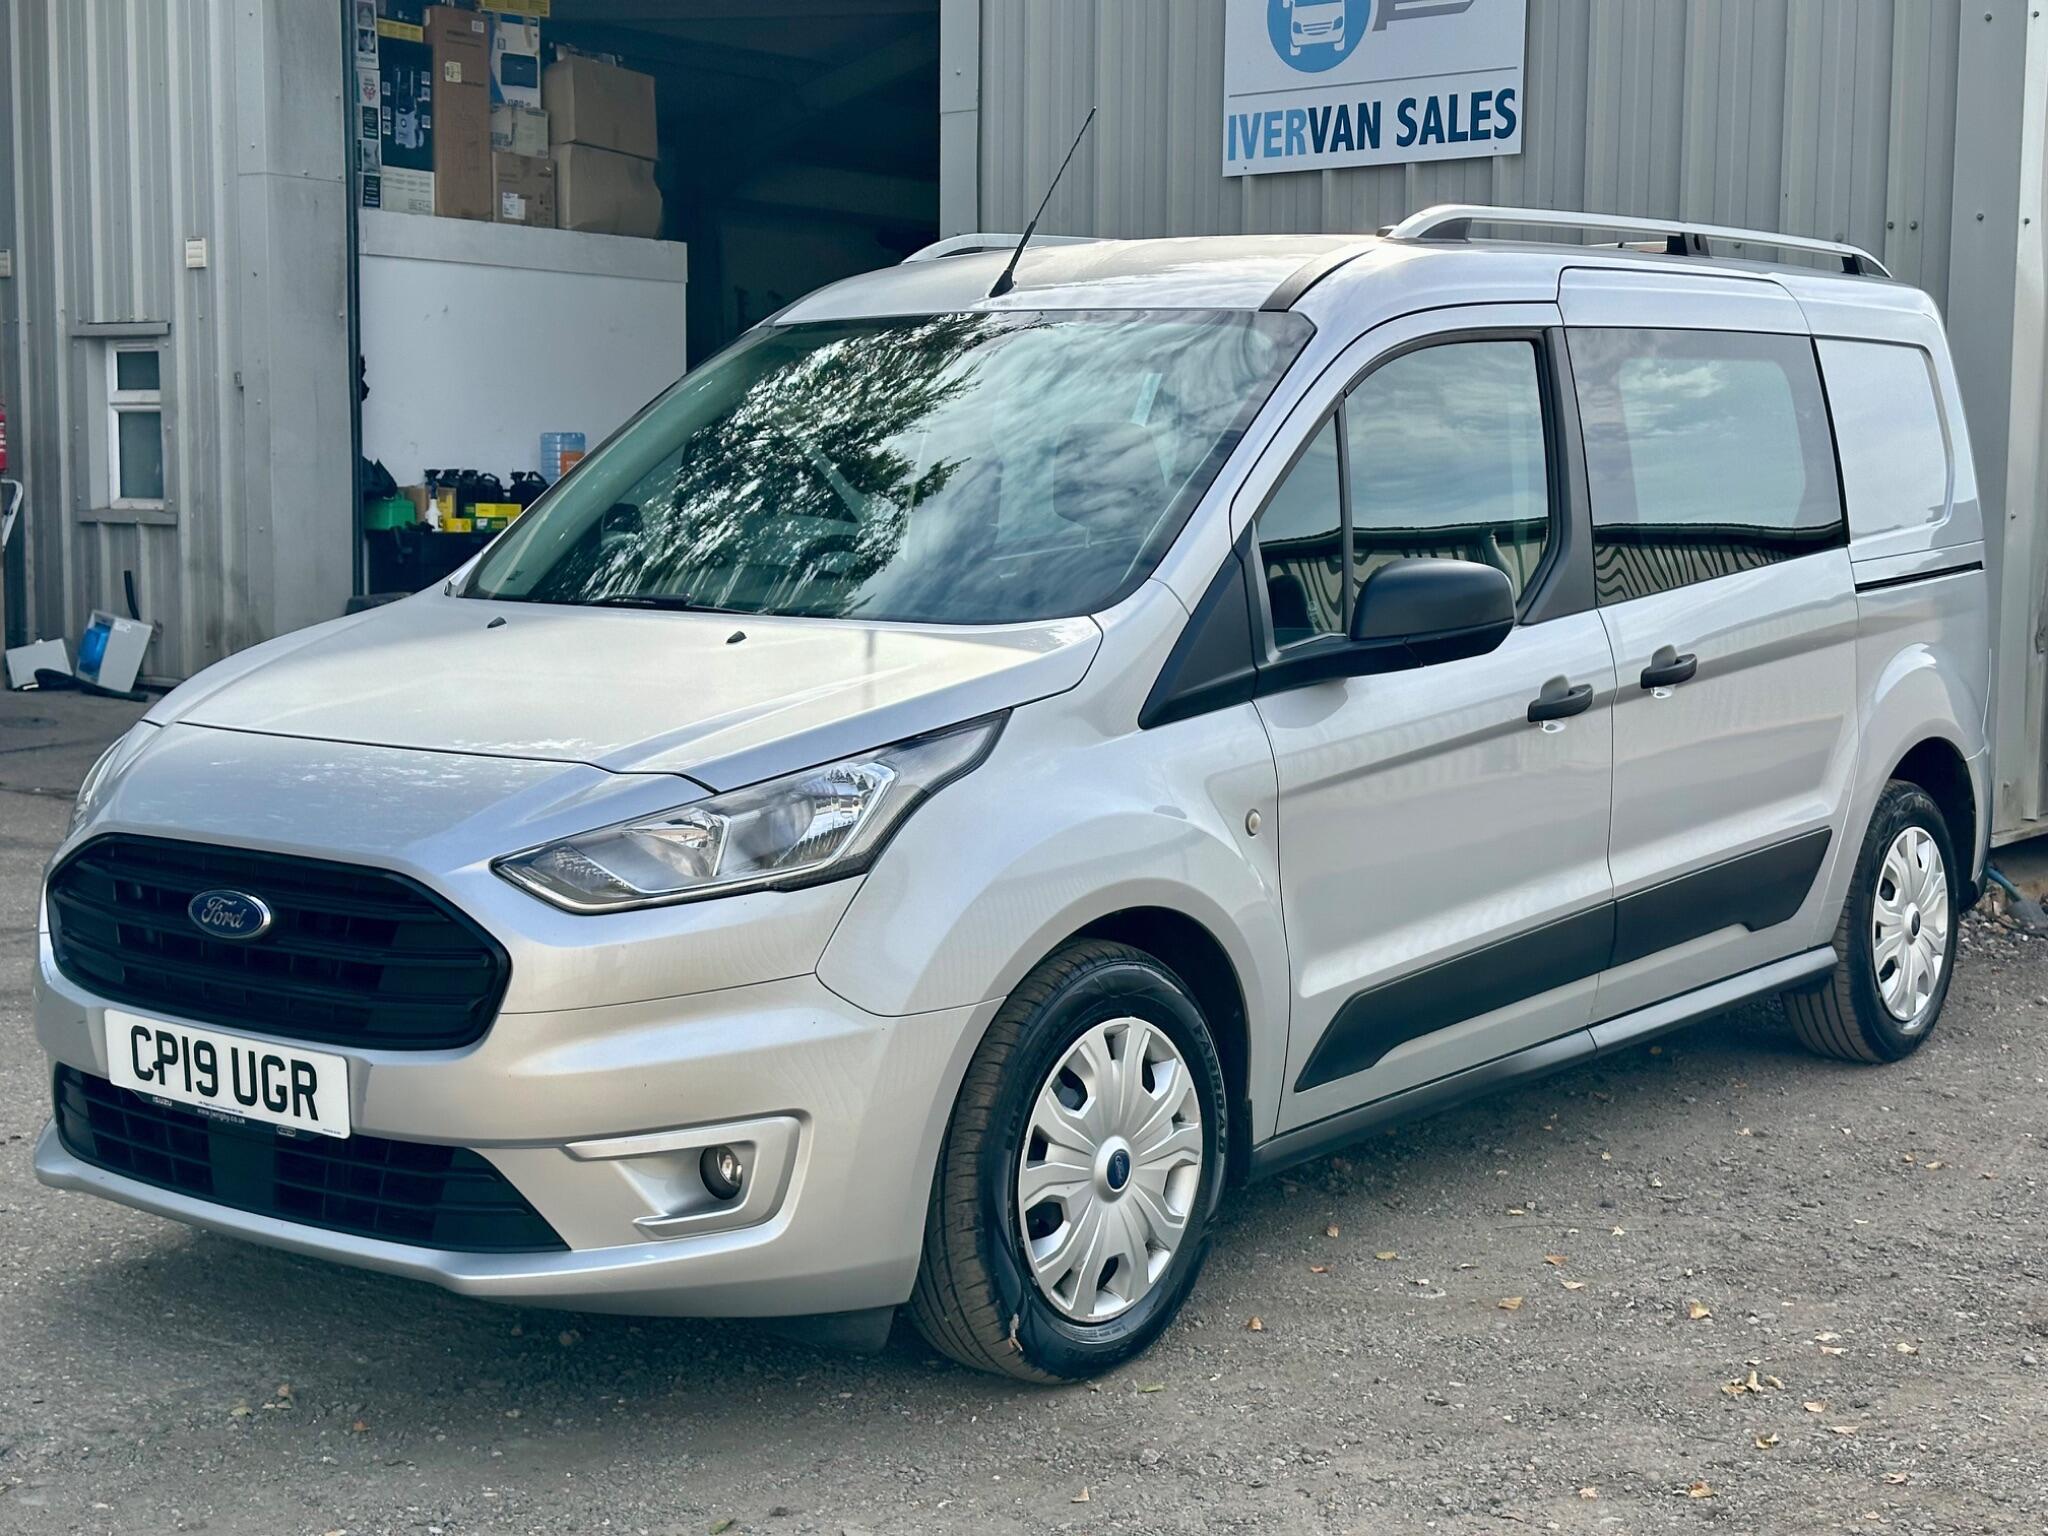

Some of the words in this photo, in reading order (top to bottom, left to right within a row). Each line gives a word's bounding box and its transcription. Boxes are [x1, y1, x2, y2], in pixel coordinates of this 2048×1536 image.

[1227, 101, 1381, 162] IVERVAN
[1396, 87, 1517, 147] SALES
[201, 896, 247, 929] Ford
[131, 1025, 219, 1098] CP19
[231, 1047, 319, 1121] UGR
